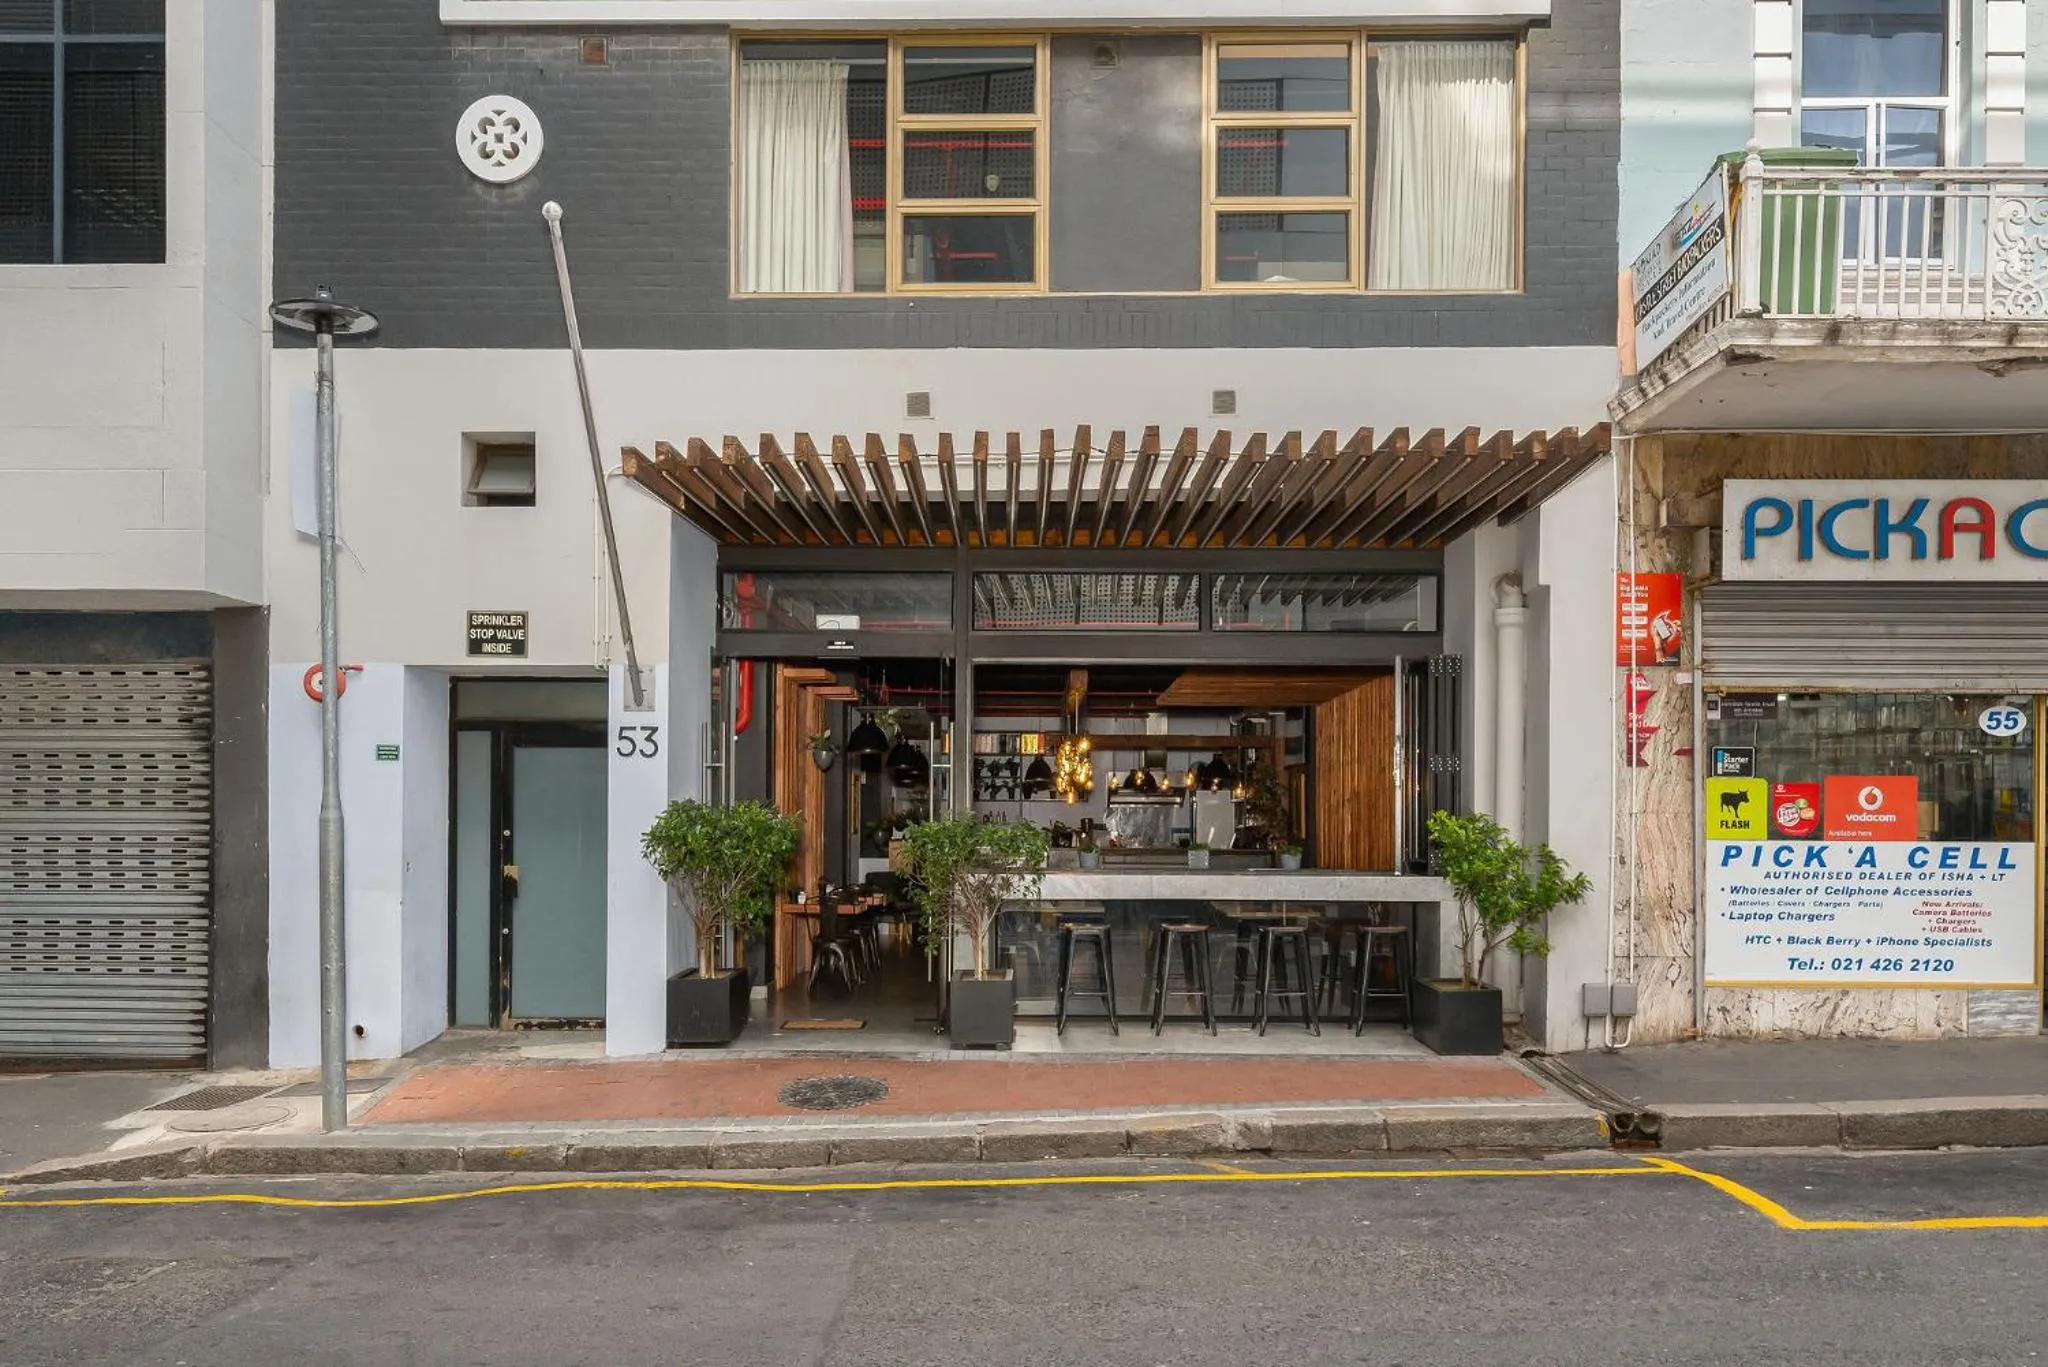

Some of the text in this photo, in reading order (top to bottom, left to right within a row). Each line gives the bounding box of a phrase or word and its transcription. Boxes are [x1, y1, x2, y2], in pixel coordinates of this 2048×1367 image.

[471, 615, 523, 626] SPRINKLER
[470, 629, 525, 640] STOP VALVE
[481, 643, 512, 653] INSIDE
[1986, 711, 2019, 730] 55
[616, 726, 659, 758] 53
[1845, 813, 1896, 822] vodacom
[1720, 820, 1750, 829] FLASH
[1721, 845, 1829, 867] PICK
[1908, 846, 2017, 869] CELL
[1764, 871, 1852, 880] AUTHORISED
[1859, 872, 1912, 881] DEALER
[1918, 872, 1936, 881] OF
[1941, 872, 1974, 881] ISHA
[1991, 873, 2006, 881] LT
[1729, 886, 1973, 897] Wholesaler of Cellphone Accessories
[1813, 900, 1851, 909] Chargers
[1729, 911, 1836, 922] Laptop Chargers
[1950, 909, 1993, 917] Batteries
[1936, 917, 1977, 926] Chargers
[1745, 935, 1772, 945] HTC
[1787, 936, 1822, 945] Black
[1826, 936, 1861, 948] Berry
[1876, 936, 1919, 946] iPhone
[1923, 937, 1993, 948] Specialists
[1788, 958, 1955, 972] Tel.: 021 426 2120
